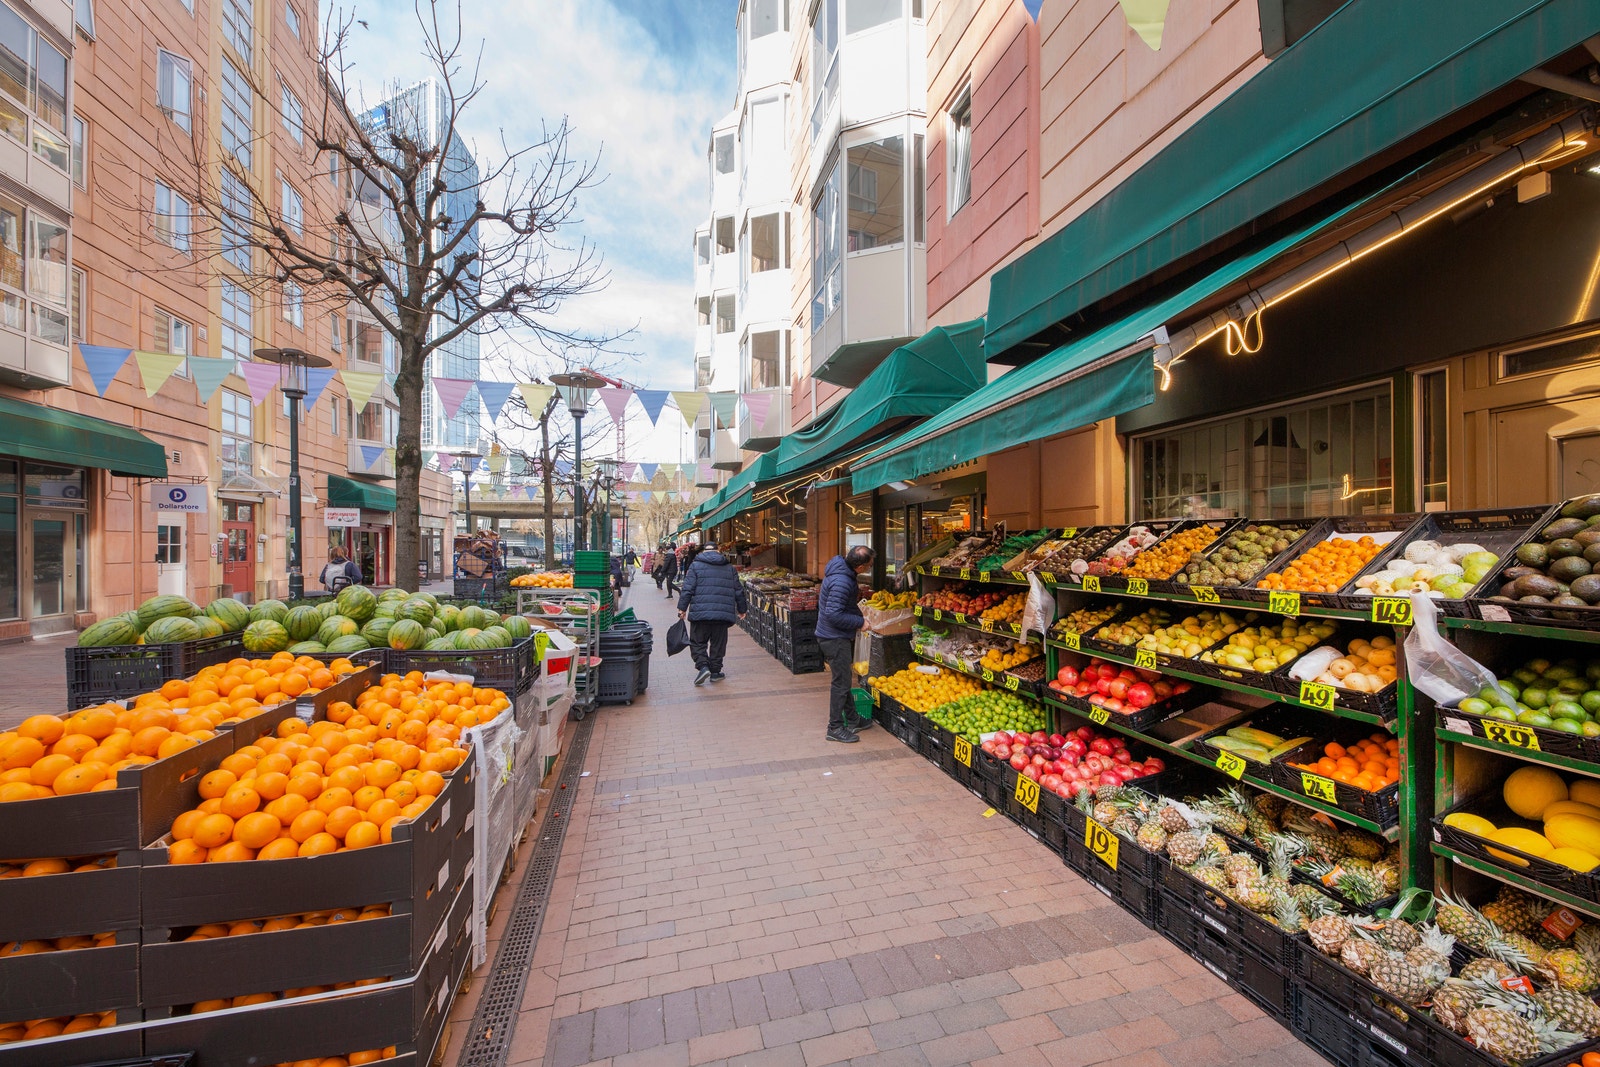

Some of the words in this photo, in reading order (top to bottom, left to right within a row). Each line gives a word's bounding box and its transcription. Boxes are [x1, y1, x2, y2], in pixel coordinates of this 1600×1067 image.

[1376, 602, 1410, 623] 149
[1302, 687, 1330, 706] 49
[1092, 709, 1106, 722] 69
[1489, 726, 1530, 747] 89
[955, 742, 968, 762] 39
[1017, 779, 1036, 806] 59
[1090, 825, 1109, 854] 19
